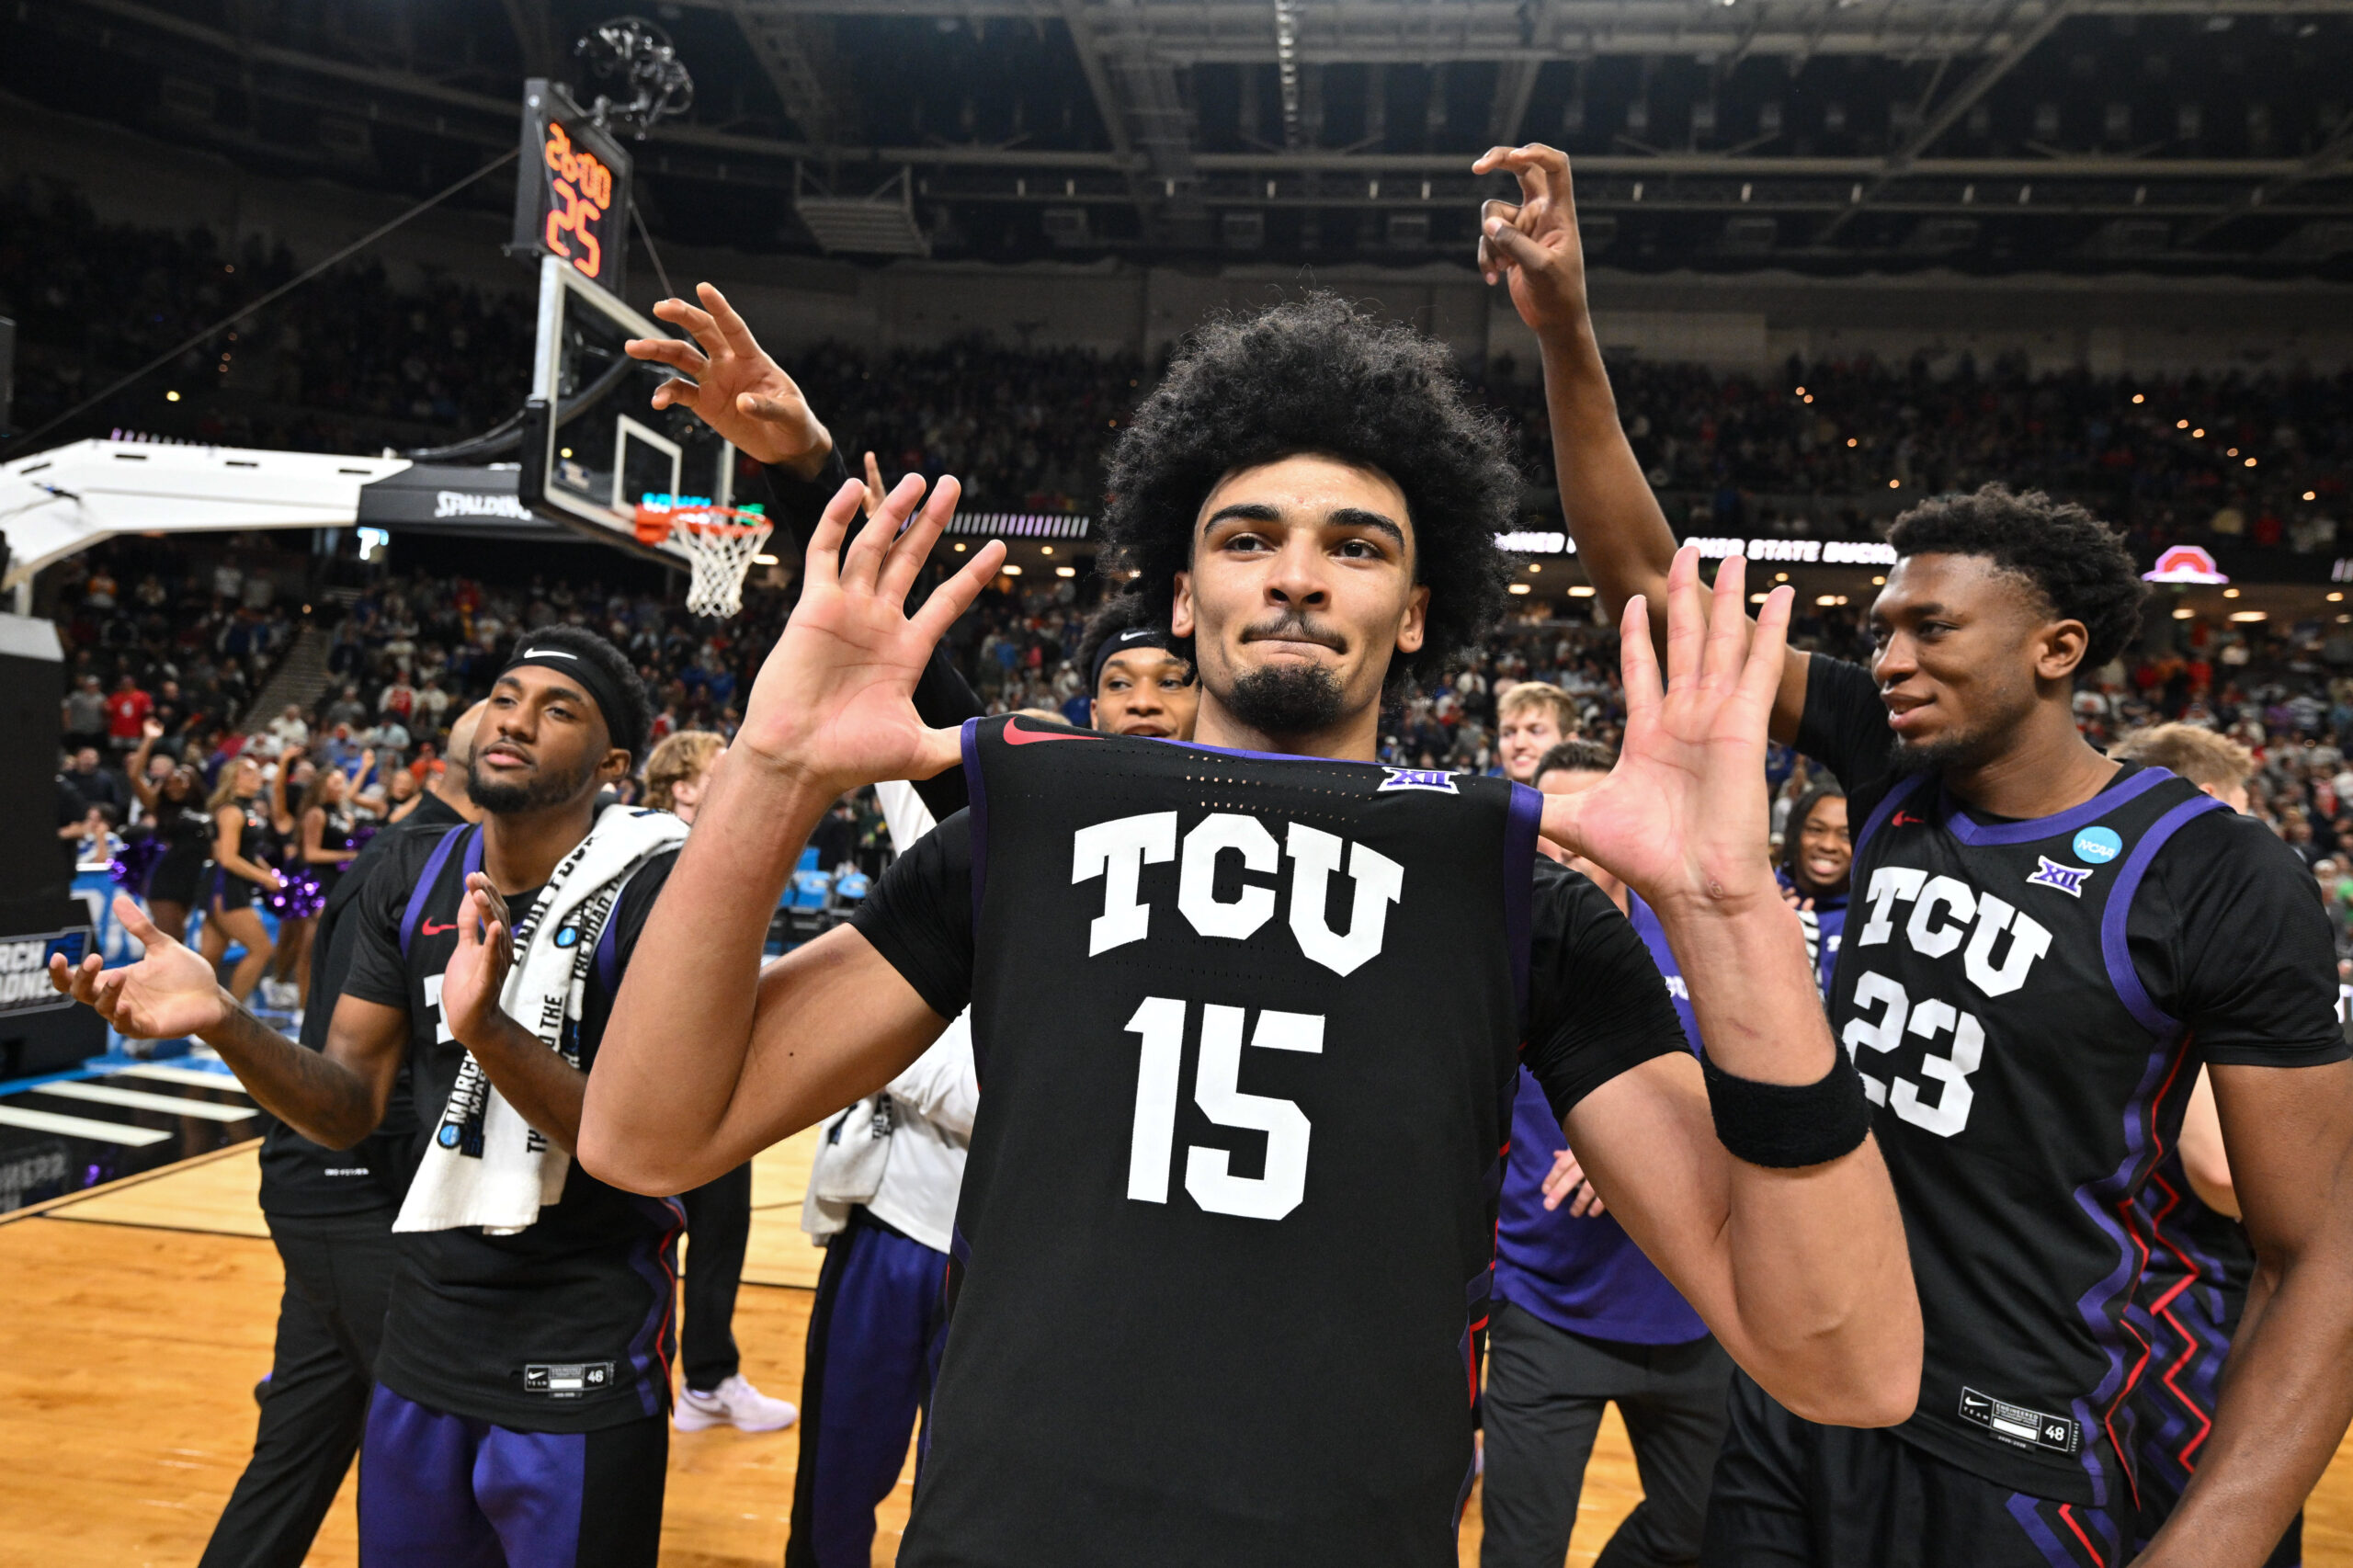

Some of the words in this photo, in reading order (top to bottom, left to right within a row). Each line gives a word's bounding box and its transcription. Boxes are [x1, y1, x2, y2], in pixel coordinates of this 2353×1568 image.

[546, 177, 601, 278] 25
[1746, 538, 1823, 562] STATE
[2029, 858, 2090, 895] XII
[2078, 838, 2116, 859] NCAA
[1072, 811, 1404, 978] TCU
[1858, 866, 2053, 998] TCU
[540, 994, 563, 1028] THE
[1842, 971, 1985, 1138] 23
[1124, 996, 1325, 1221] 15
[2045, 1425, 2065, 1441] 48
